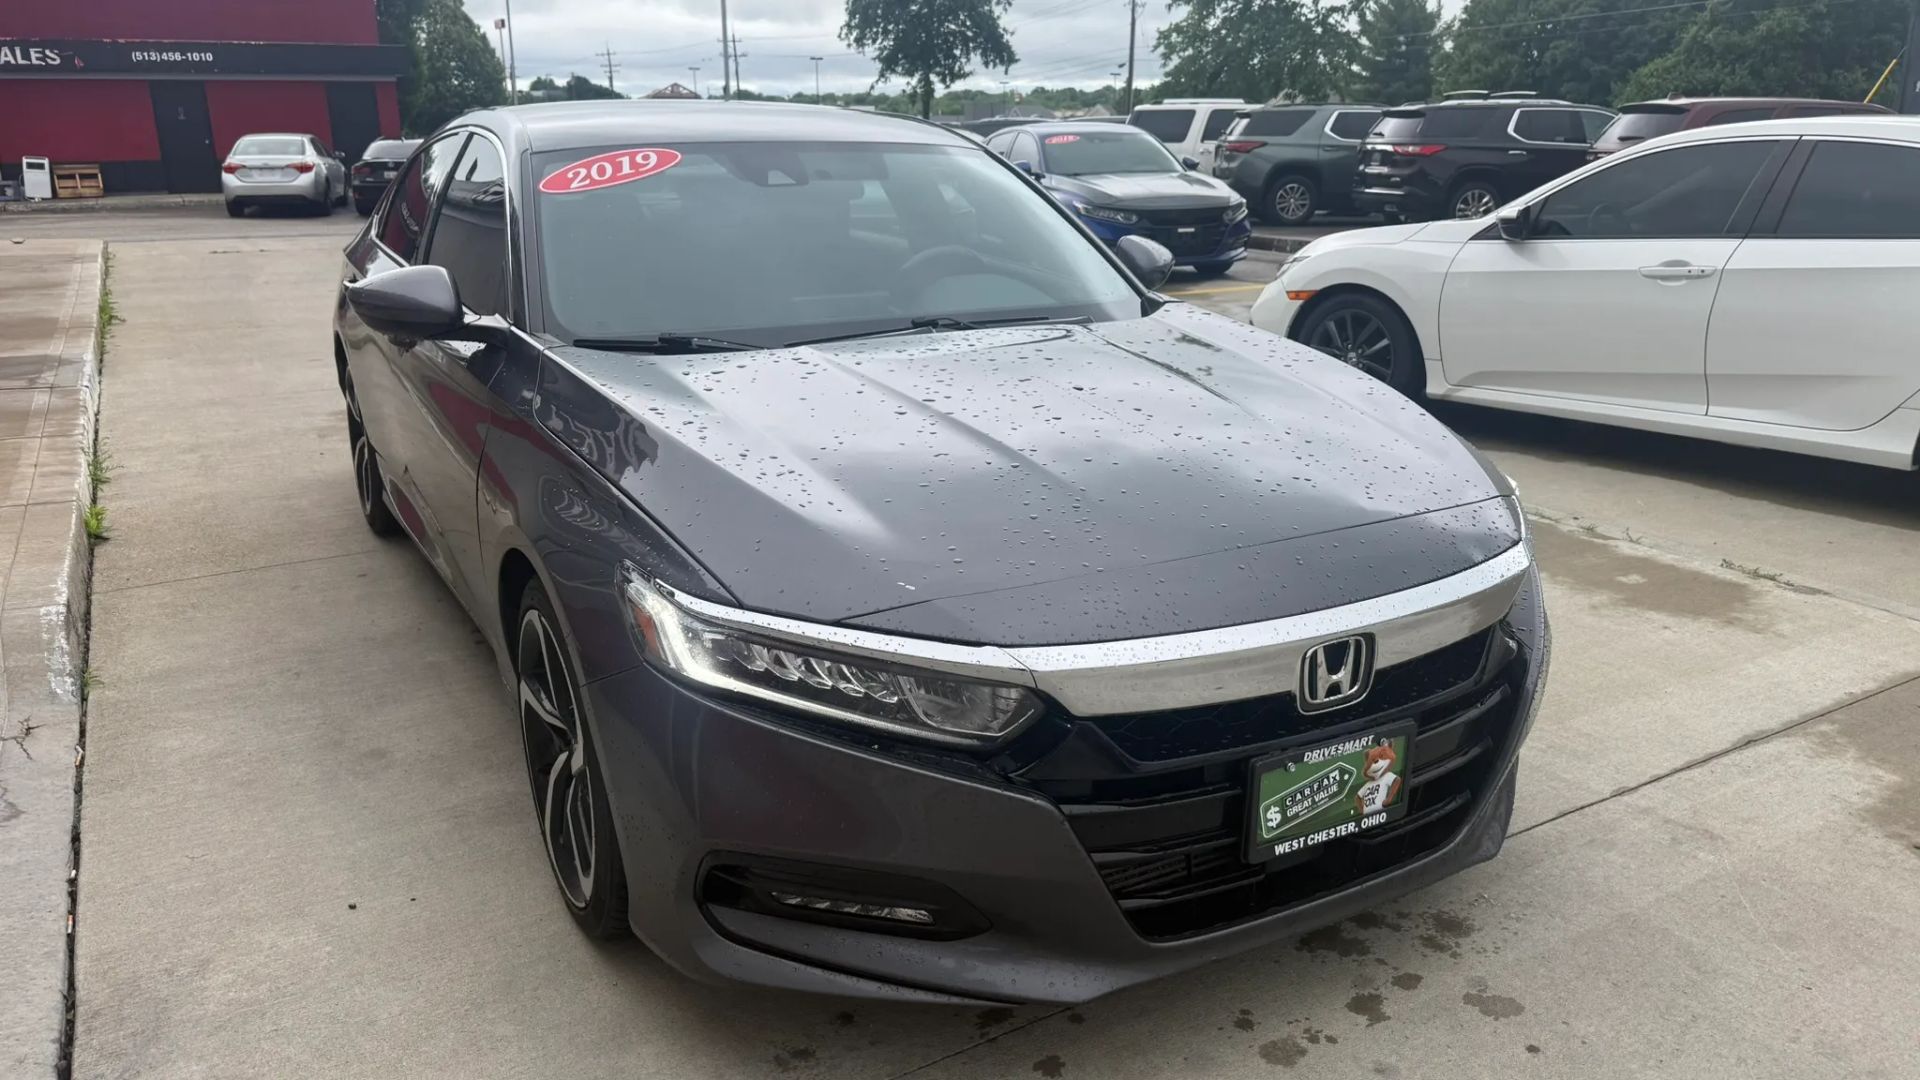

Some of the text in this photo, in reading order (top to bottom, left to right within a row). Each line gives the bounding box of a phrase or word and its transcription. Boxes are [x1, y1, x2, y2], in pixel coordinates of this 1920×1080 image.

[0, 46, 61, 66] ALES
[567, 151, 658, 189] 2019
[1303, 735, 1375, 763] DRIVESMART
[1285, 769, 1340, 806] CARFAX
[1287, 797, 1313, 817] GREAT
[1313, 783, 1339, 802] VALUE
[1362, 795, 1378, 808] OX
[1274, 812, 1387, 856] WEST CHESTER, OHIO
